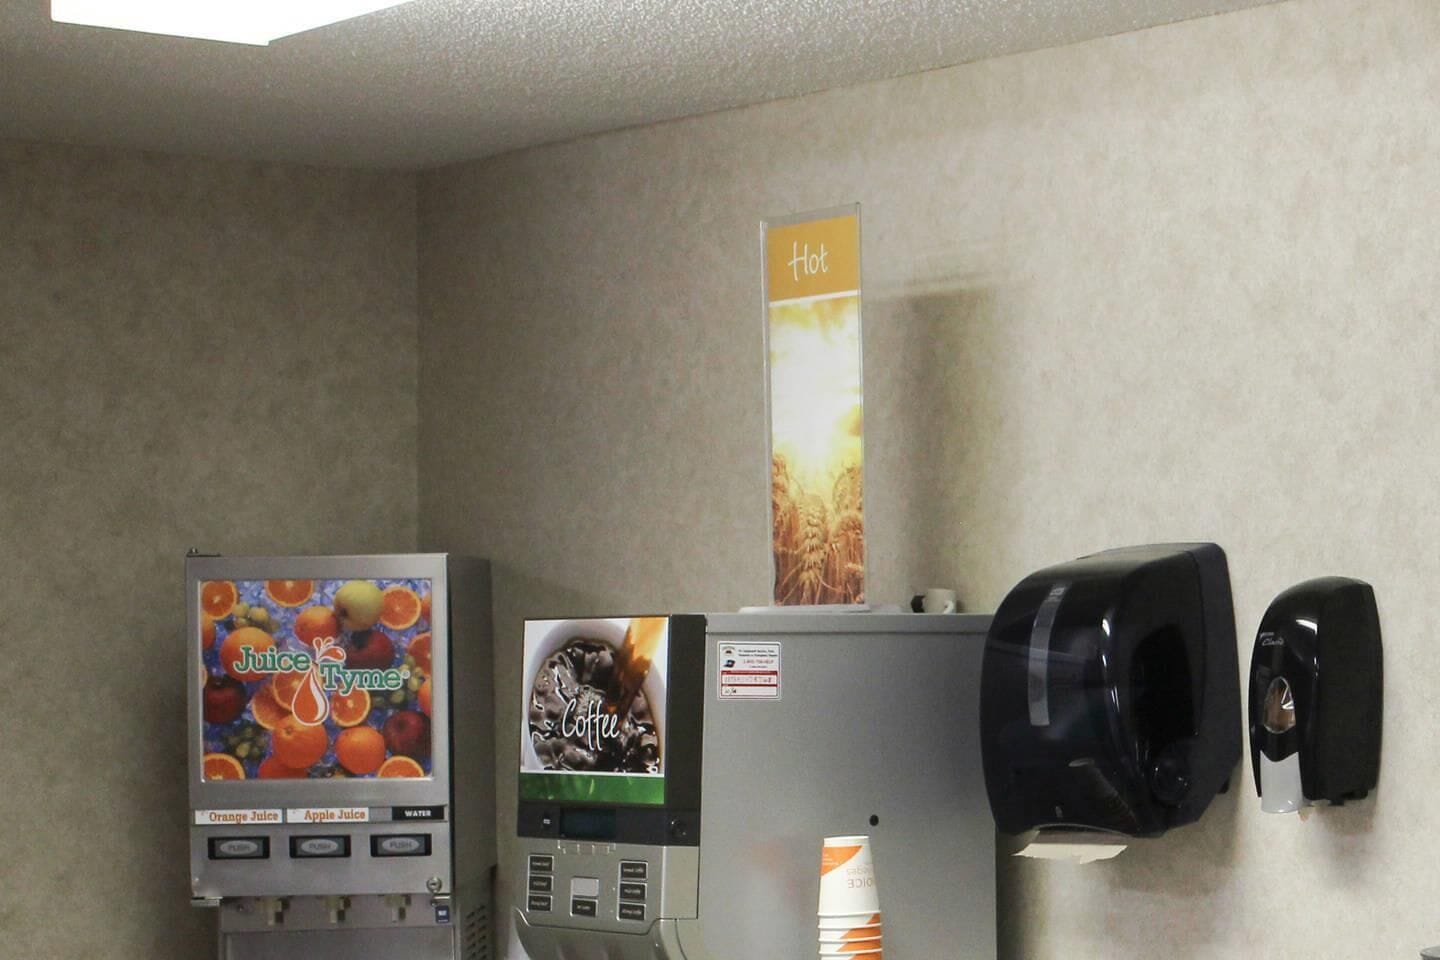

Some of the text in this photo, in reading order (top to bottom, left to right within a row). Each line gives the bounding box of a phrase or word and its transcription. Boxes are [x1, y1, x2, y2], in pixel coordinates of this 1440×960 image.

[787, 240, 829, 281] Hot
[233, 645, 312, 673] Juice
[319, 662, 403, 696] Tyme
[562, 698, 620, 751] Coffee
[209, 810, 279, 824] Orange Juice
[304, 809, 366, 823] Apple Juice
[404, 809, 432, 818] WATER
[309, 842, 332, 850] PUSH
[389, 840, 413, 849] PUSH
